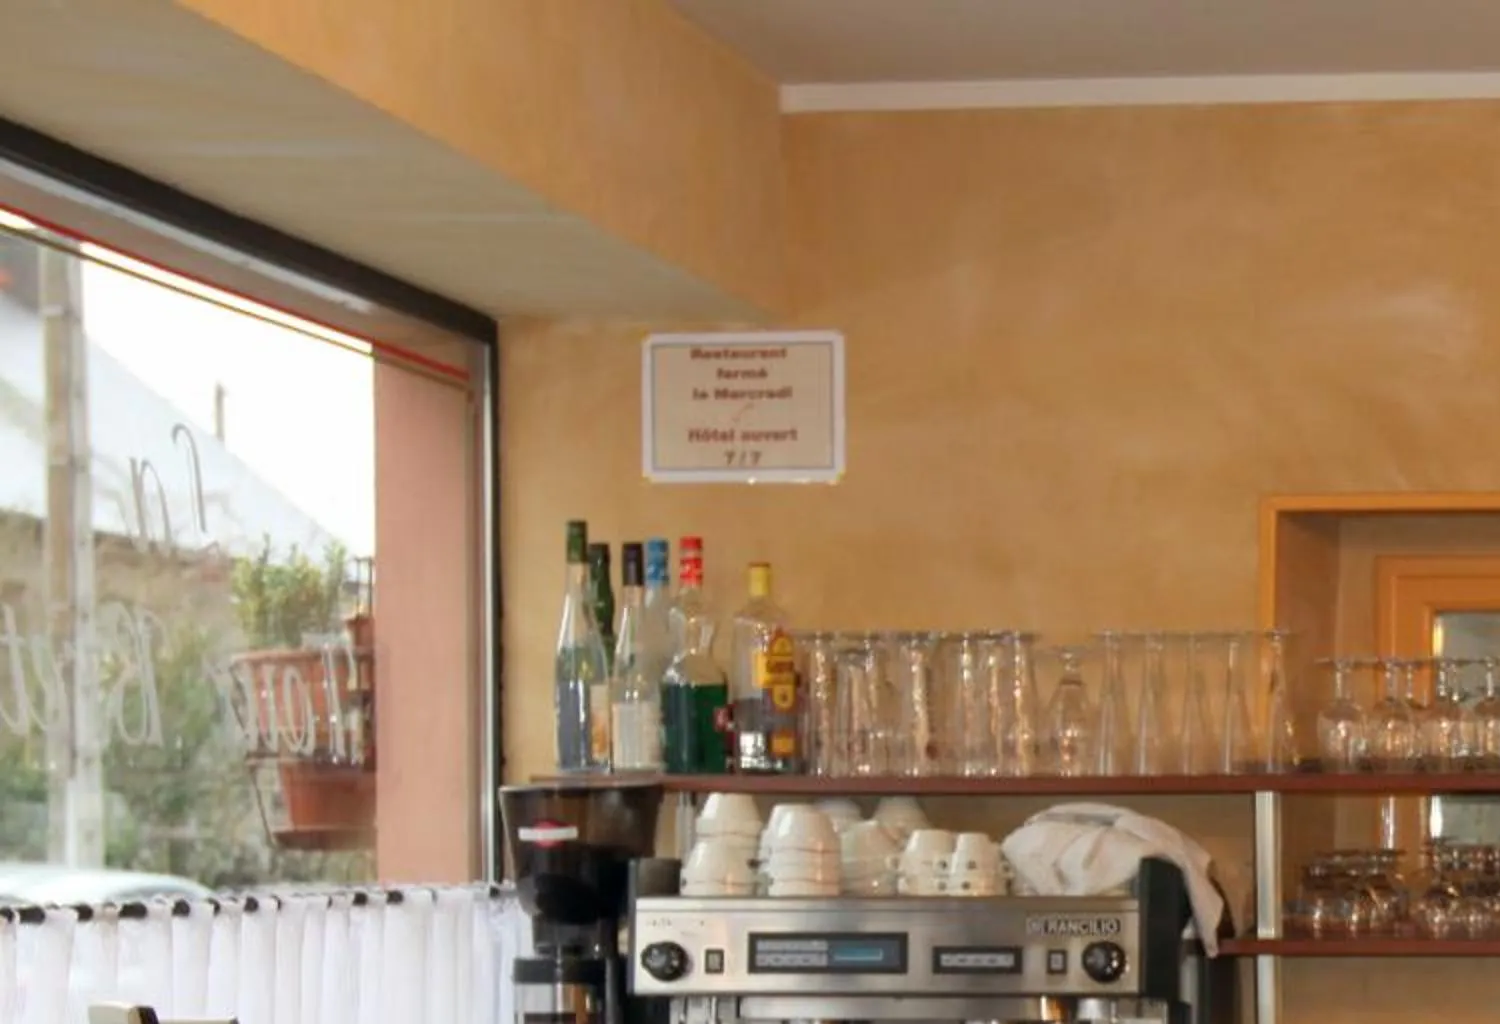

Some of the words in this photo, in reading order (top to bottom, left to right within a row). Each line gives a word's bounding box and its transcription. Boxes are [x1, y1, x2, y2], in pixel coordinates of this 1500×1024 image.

[690, 346, 787, 360] Restaurant
[714, 386, 793, 400] Mercredi
[687, 428, 735, 443] Hôtel
[742, 429, 798, 441] ouvert
[1047, 918, 1121, 935] RANCILIO
